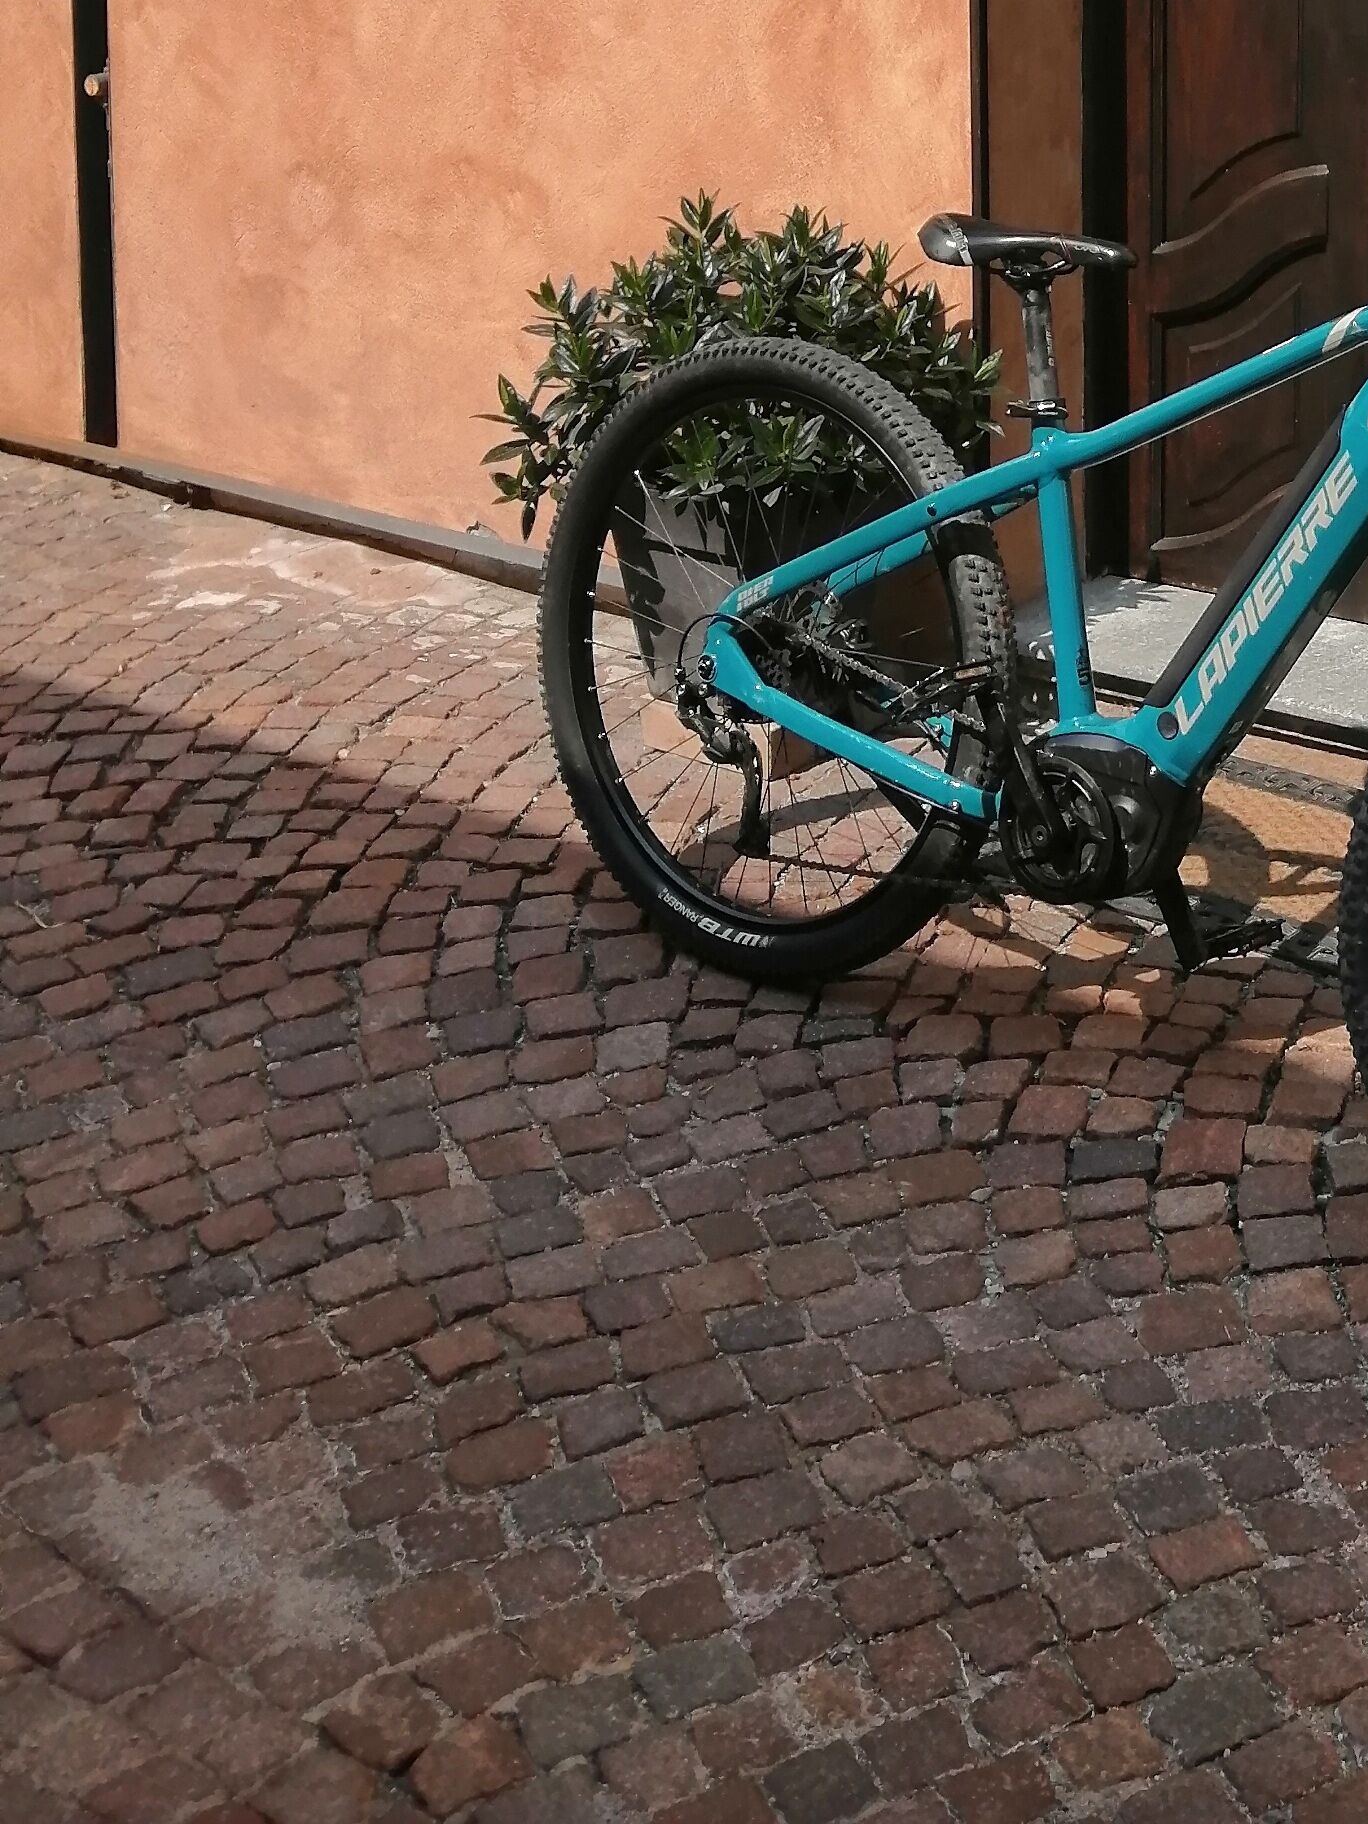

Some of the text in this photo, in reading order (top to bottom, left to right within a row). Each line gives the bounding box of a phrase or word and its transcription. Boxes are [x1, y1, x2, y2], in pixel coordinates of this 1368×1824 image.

[1174, 449, 1358, 735] LAPIERRE
[662, 891, 699, 923] RANGER
[697, 917, 761, 948] WTB
